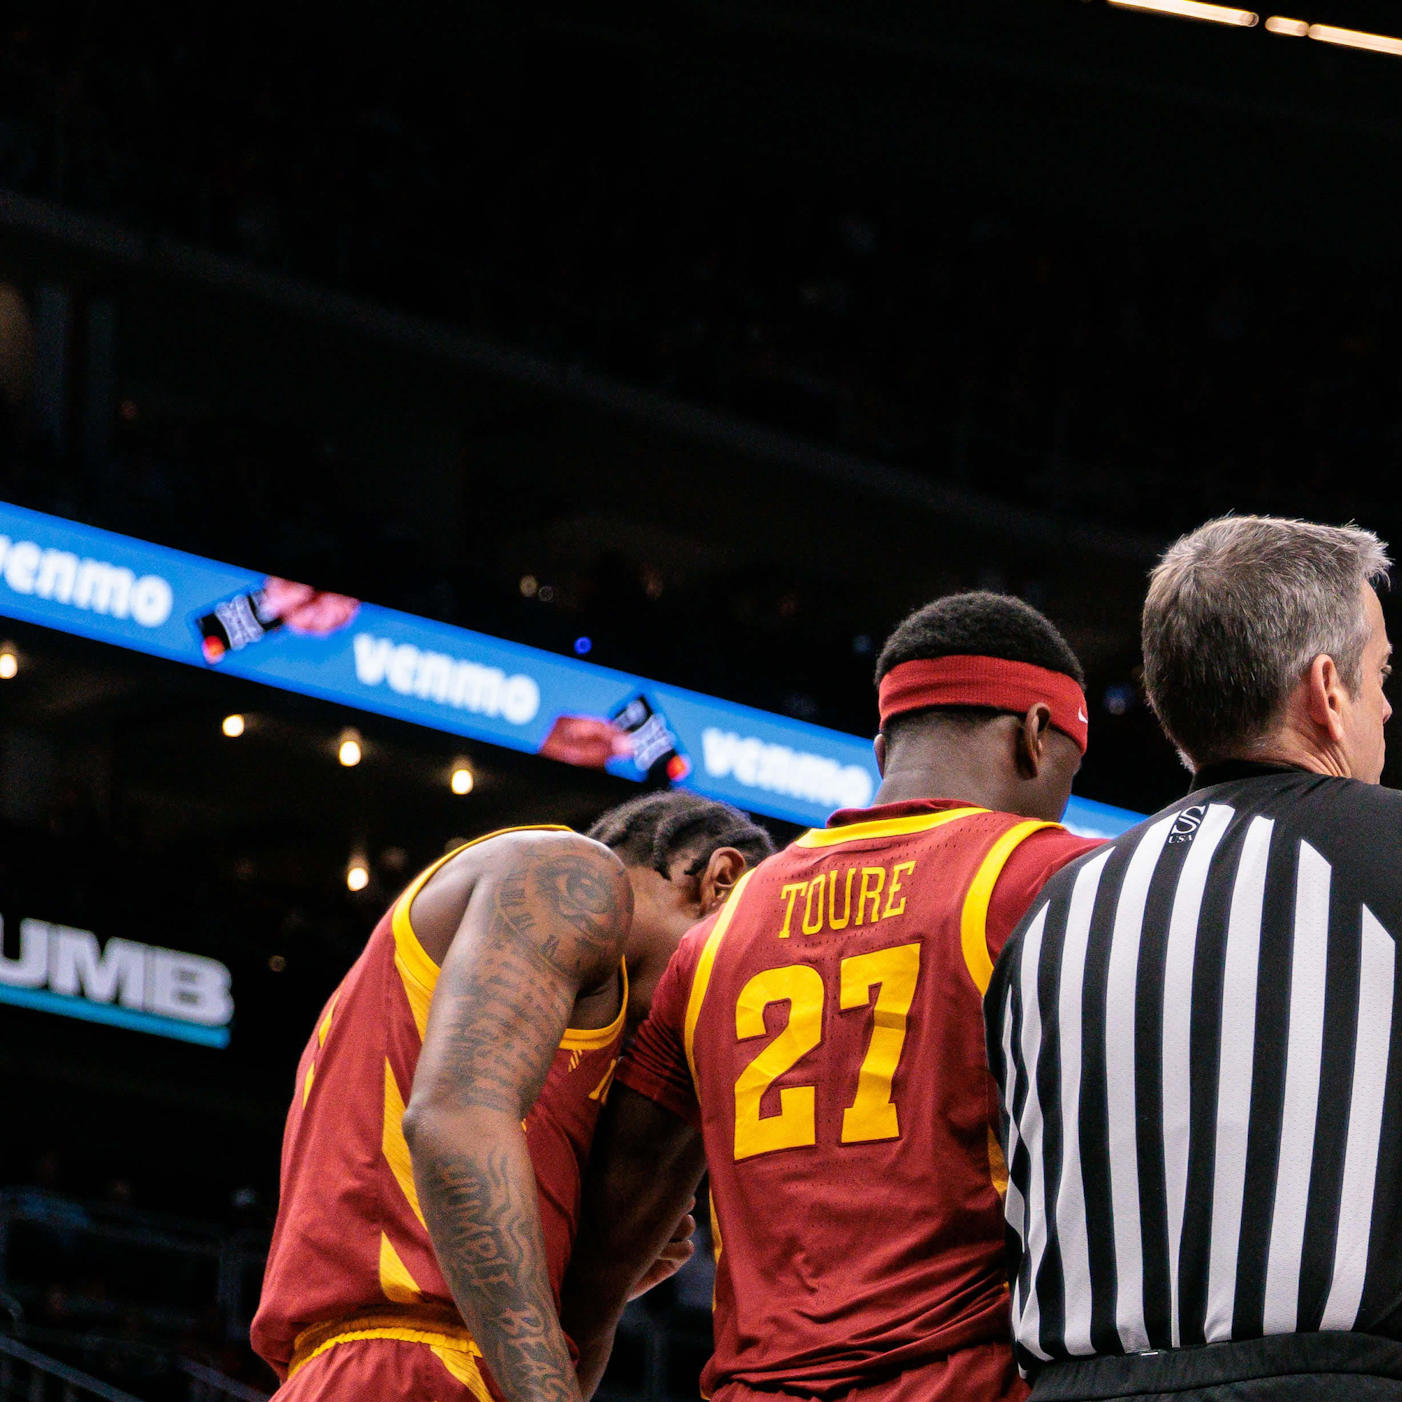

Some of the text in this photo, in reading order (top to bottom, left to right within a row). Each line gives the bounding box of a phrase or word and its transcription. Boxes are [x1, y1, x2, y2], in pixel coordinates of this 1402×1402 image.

[353, 633, 540, 725] venmo
[702, 726, 873, 809] venmo
[779, 860, 915, 939] TOURE
[734, 943, 921, 1162] 27
